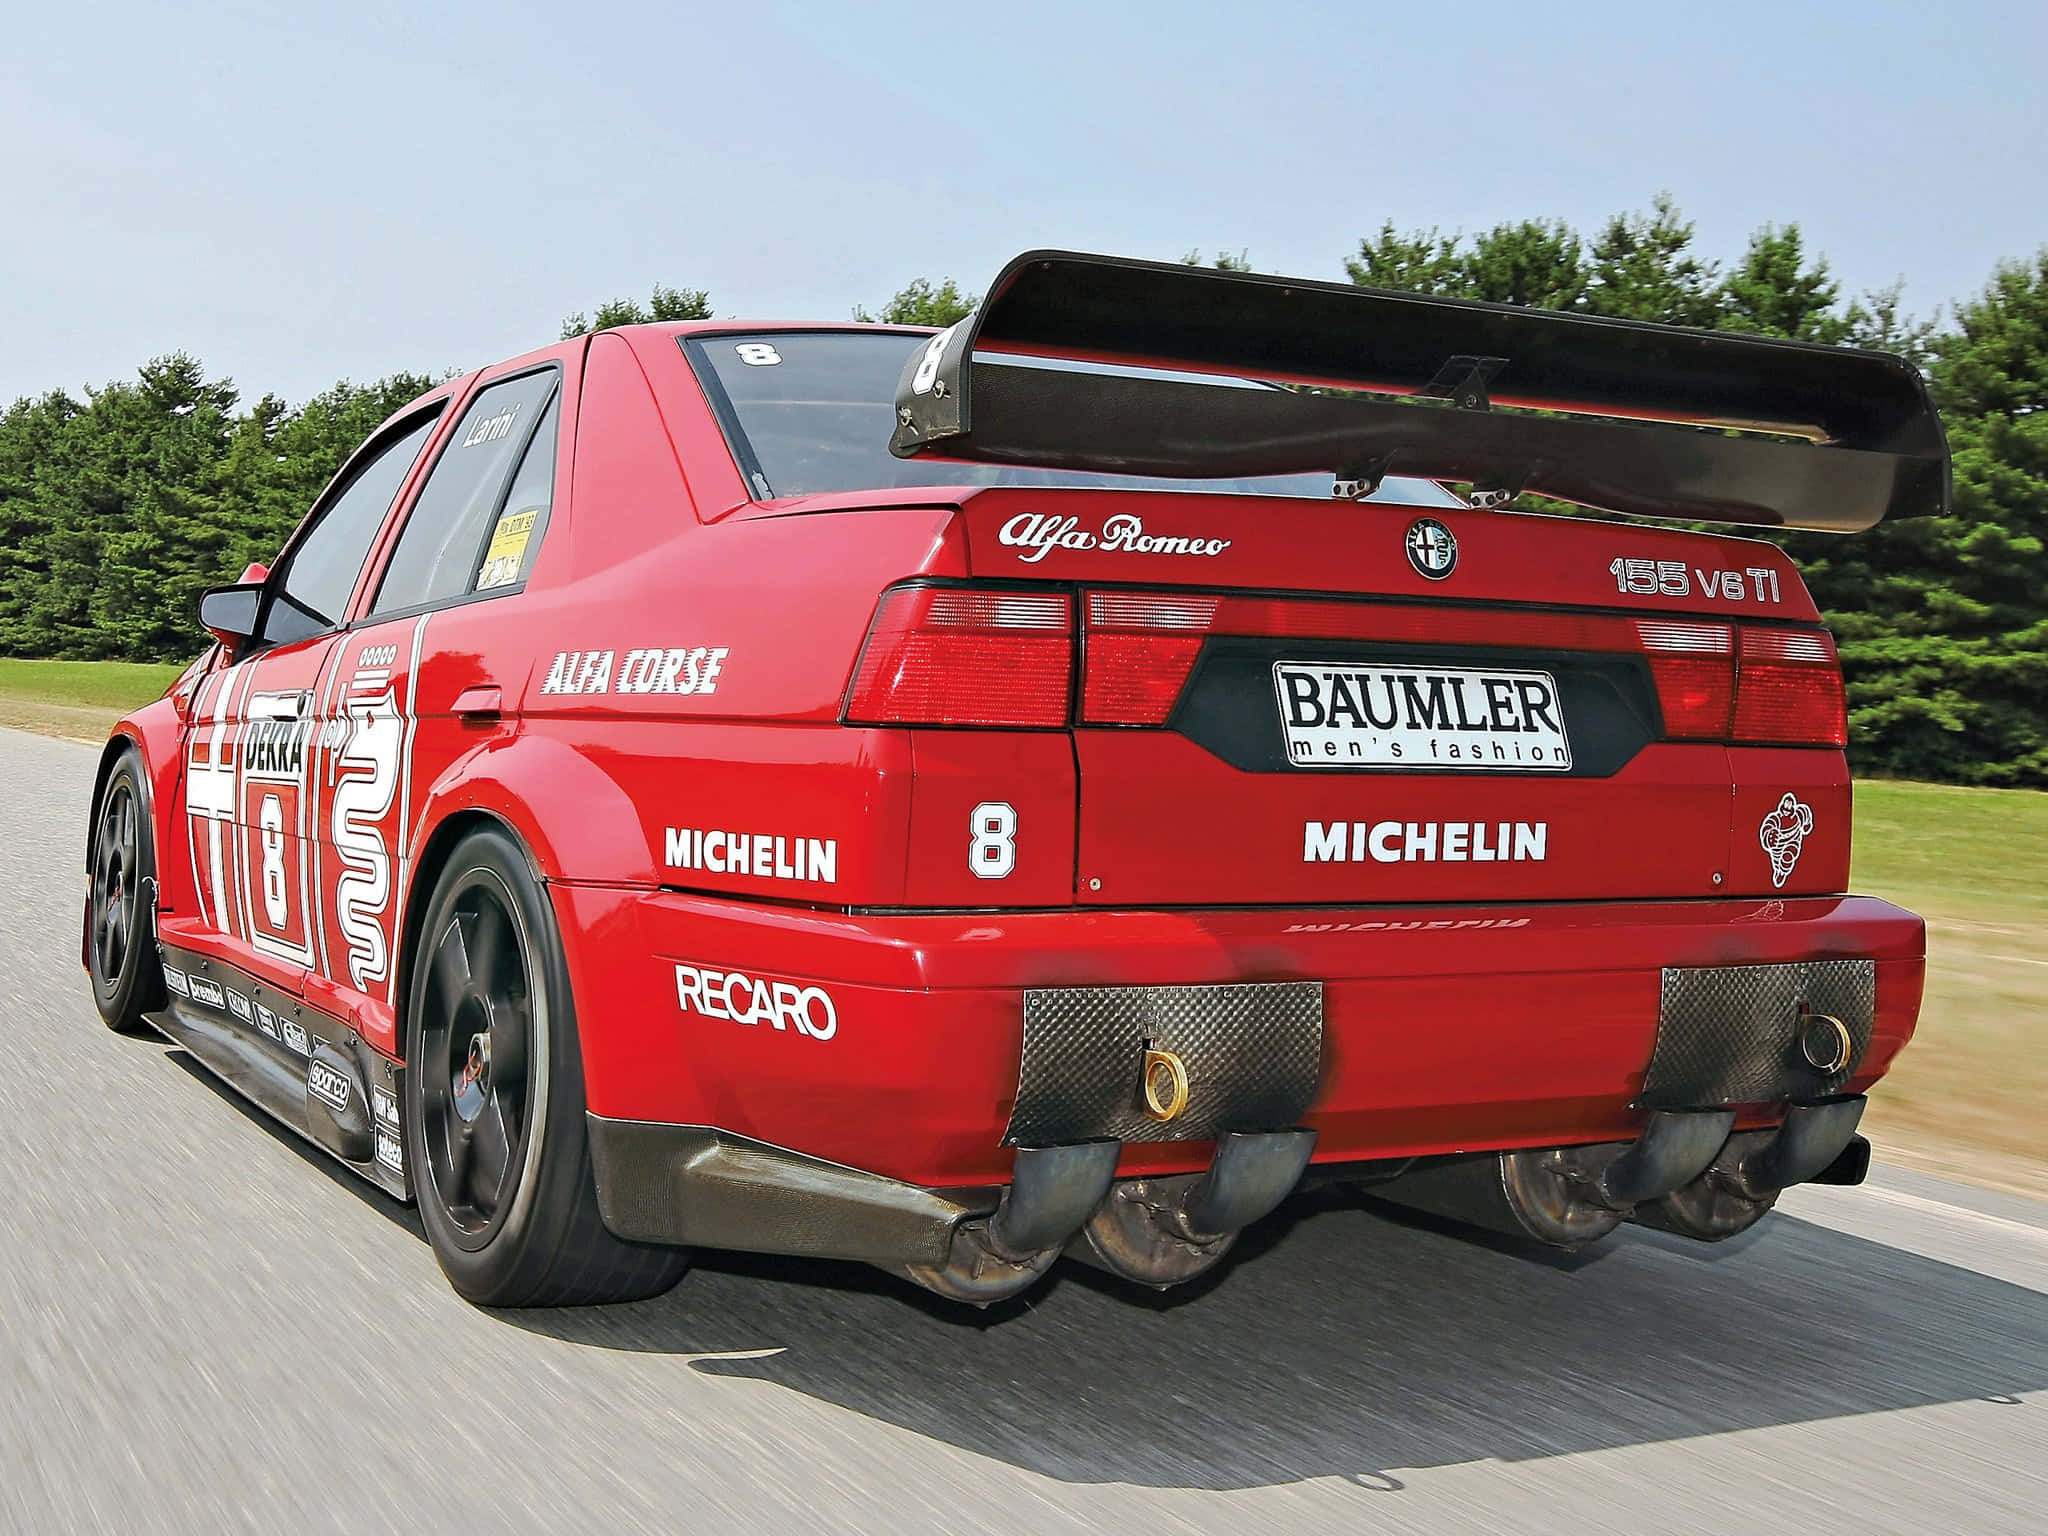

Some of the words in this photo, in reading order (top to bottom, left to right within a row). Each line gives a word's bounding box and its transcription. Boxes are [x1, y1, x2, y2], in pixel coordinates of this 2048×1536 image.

[734, 343, 783, 366] 8
[911, 325, 958, 396] 8
[463, 403, 521, 448] Larini
[998, 512, 1097, 562] Alfa
[1099, 513, 1231, 556] Romeo
[1610, 558, 1690, 596] 155
[539, 650, 615, 695] ALFA
[615, 646, 730, 696] CORSE
[1281, 672, 1561, 735] BÄUMLER
[246, 722, 305, 773] DEKRA
[1293, 737, 1404, 758] men's
[1430, 738, 1570, 762] fashion
[259, 793, 289, 931] 8
[664, 826, 838, 884] MICHELIN
[968, 801, 1018, 879] 8
[1303, 821, 1548, 863] MICHELIN
[190, 982, 226, 1006] brembo
[675, 964, 838, 1042] RECARO
[311, 1065, 348, 1099] sparco
